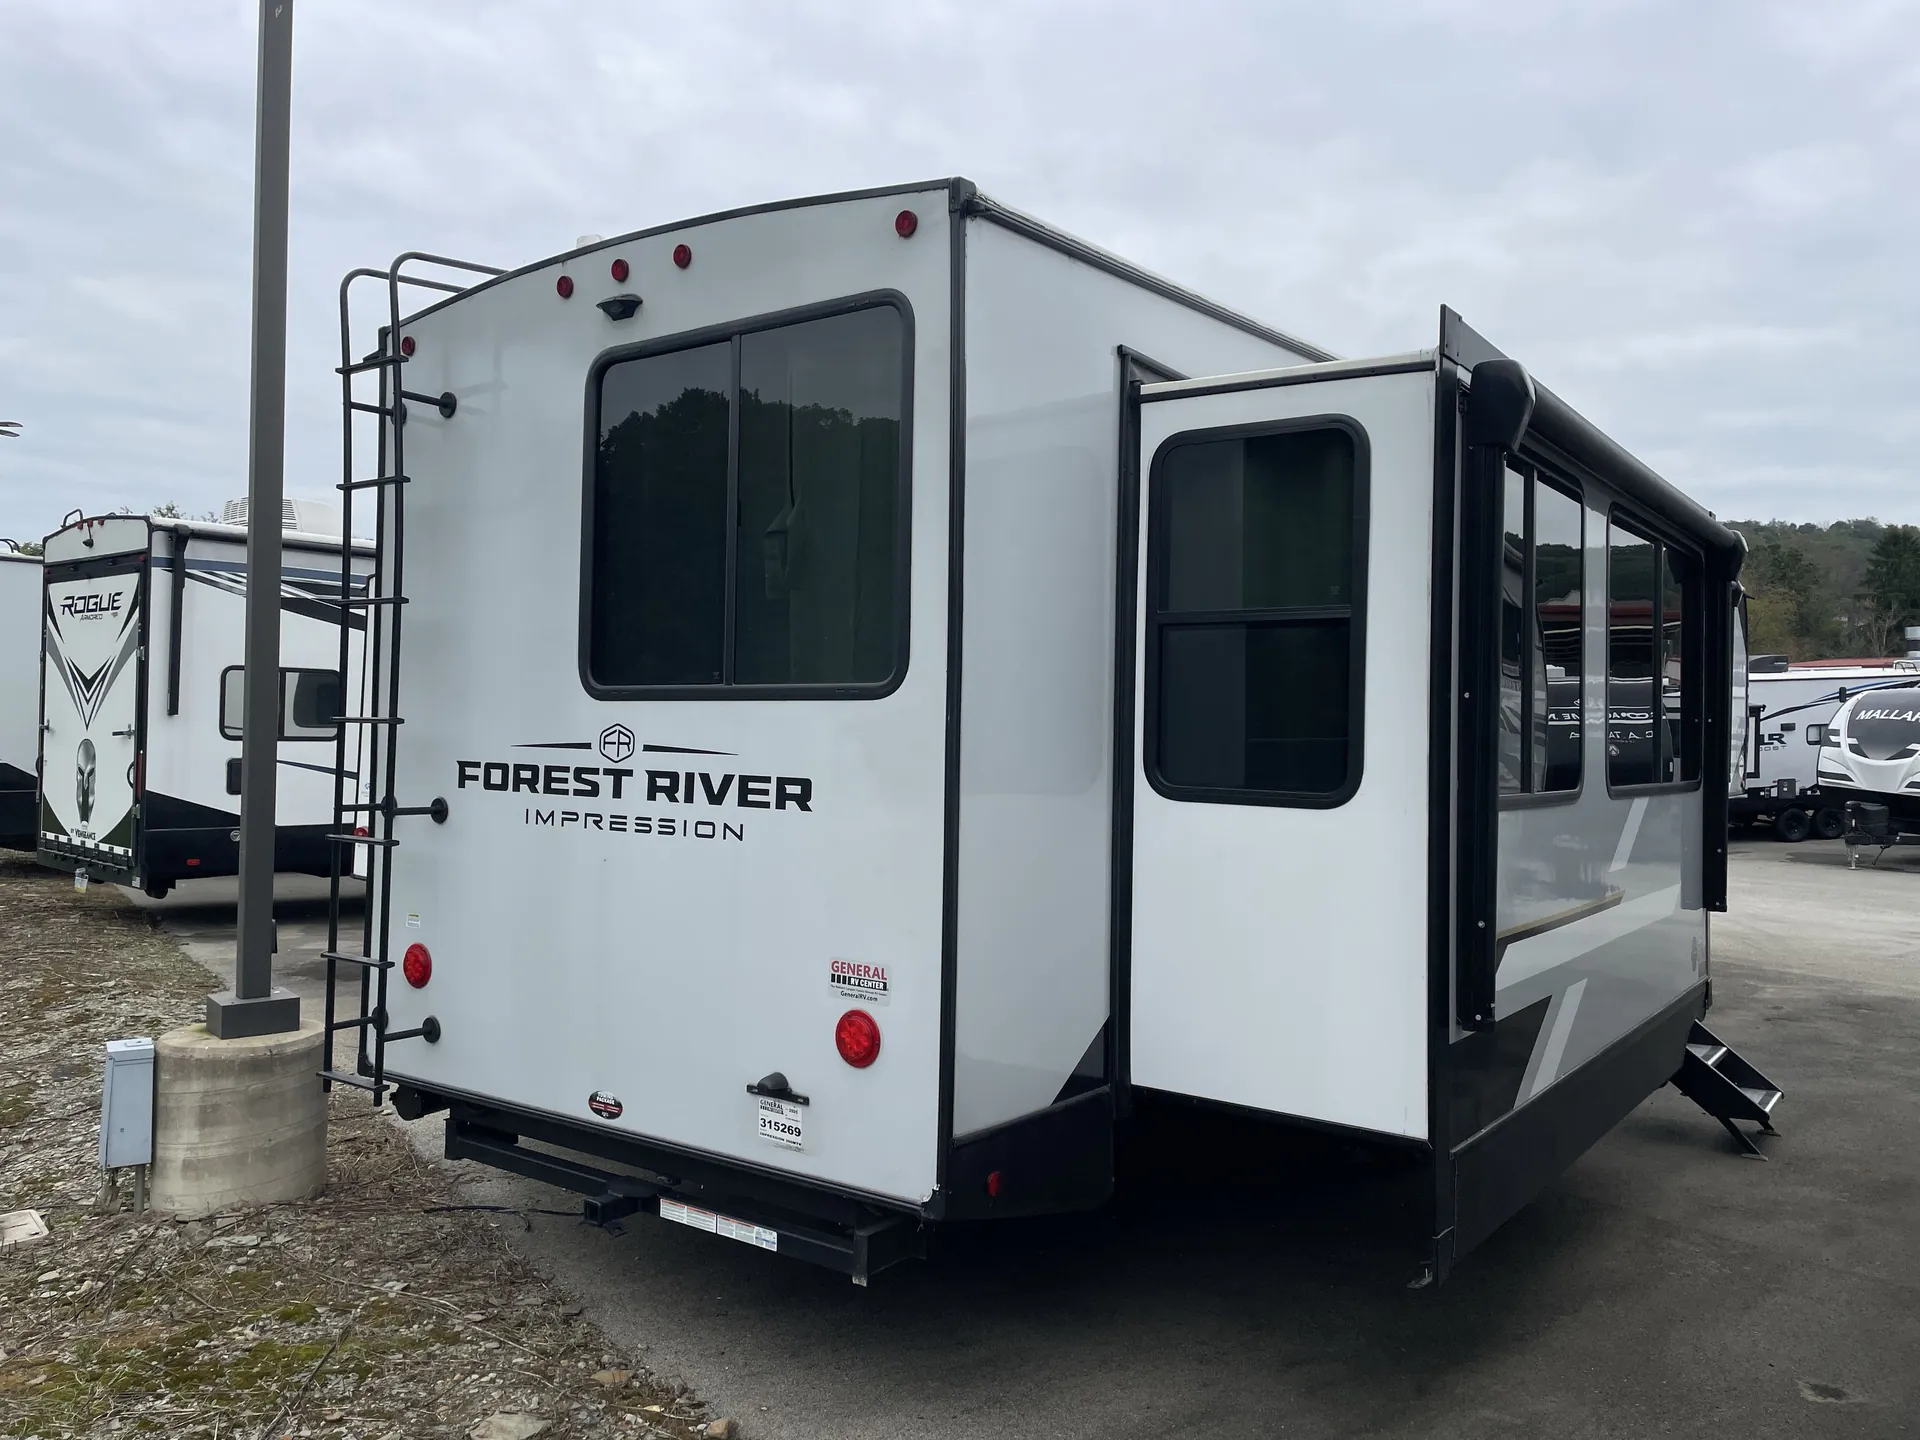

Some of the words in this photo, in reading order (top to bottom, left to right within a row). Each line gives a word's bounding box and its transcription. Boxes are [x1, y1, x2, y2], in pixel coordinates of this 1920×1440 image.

[60, 591, 124, 619] ROGUE
[456, 760, 633, 799] FOREST
[645, 770, 813, 813] RIVER
[525, 808, 745, 842] IMPRESSION
[831, 960, 888, 981] GENERAL
[850, 977, 860, 986] RV
[860, 979, 884, 990] CENTER
[840, 990, 878, 1002] GeneralRV.com
[760, 1117, 802, 1137] 315269
